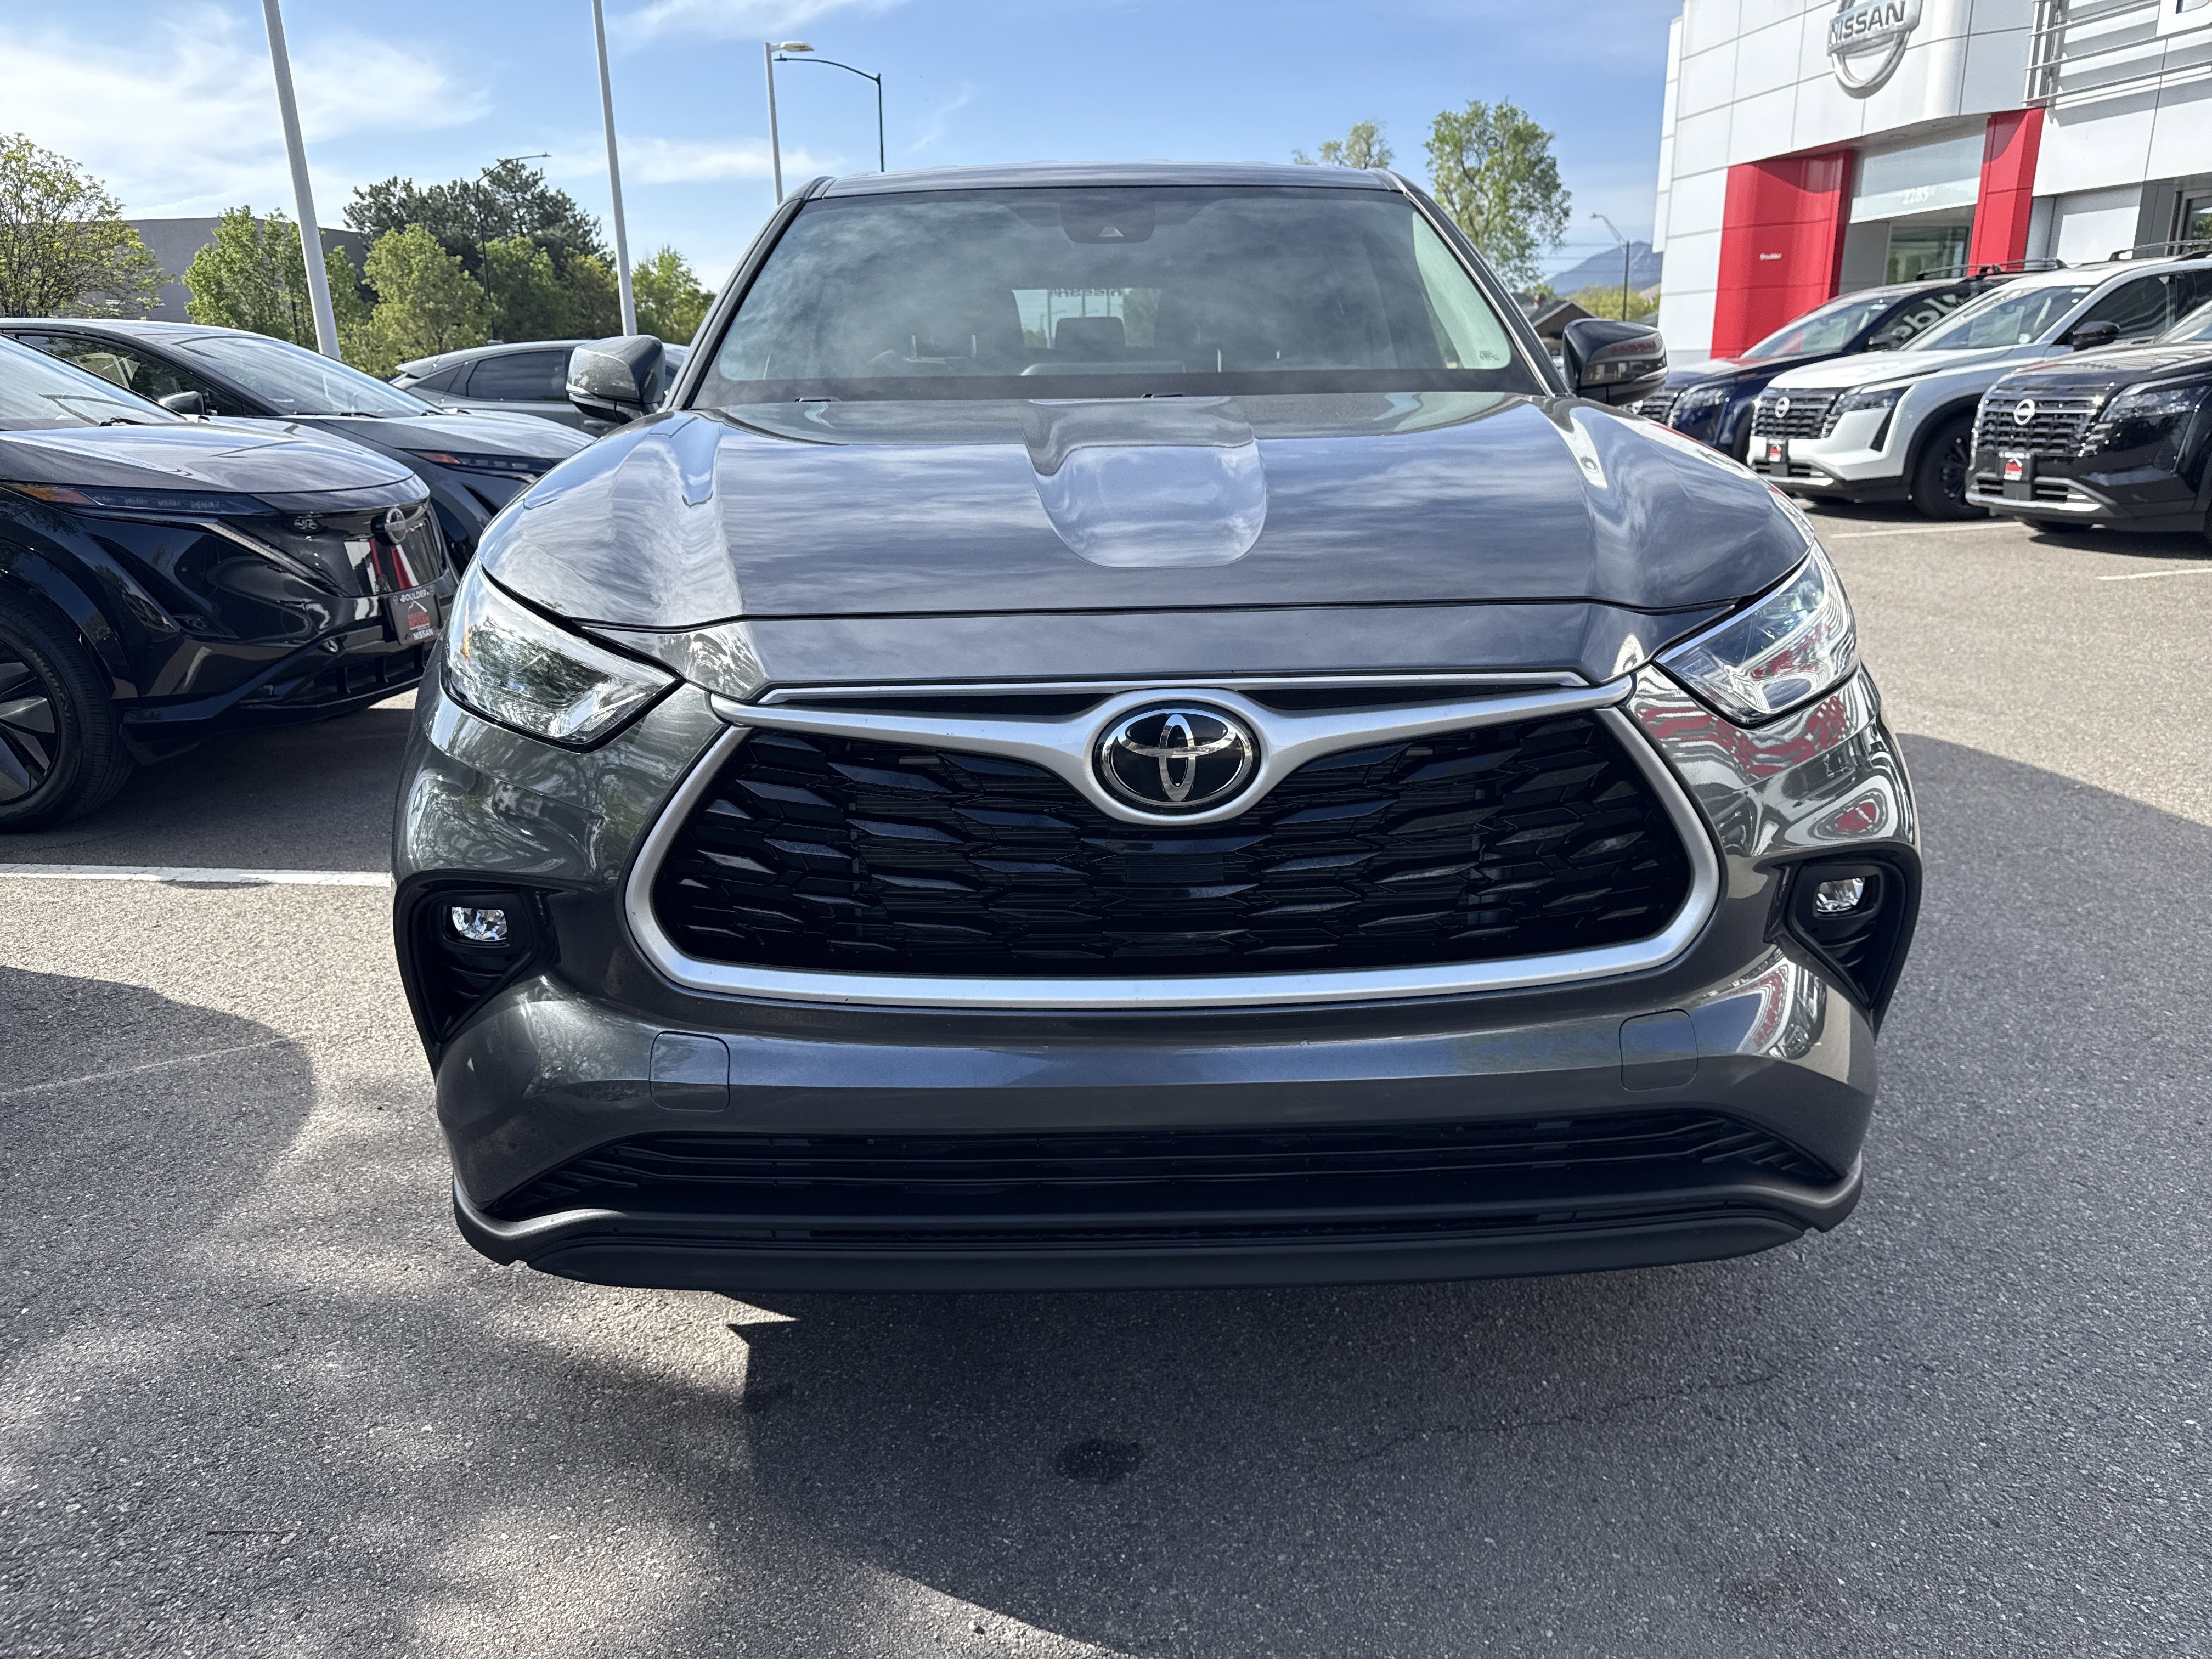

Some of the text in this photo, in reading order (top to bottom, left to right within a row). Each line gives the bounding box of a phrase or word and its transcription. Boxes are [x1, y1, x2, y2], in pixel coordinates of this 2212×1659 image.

[1829, 0, 1905, 45] NISSAN
[401, 589, 427, 602] BOULDER
[413, 628, 433, 641] NISSAN
